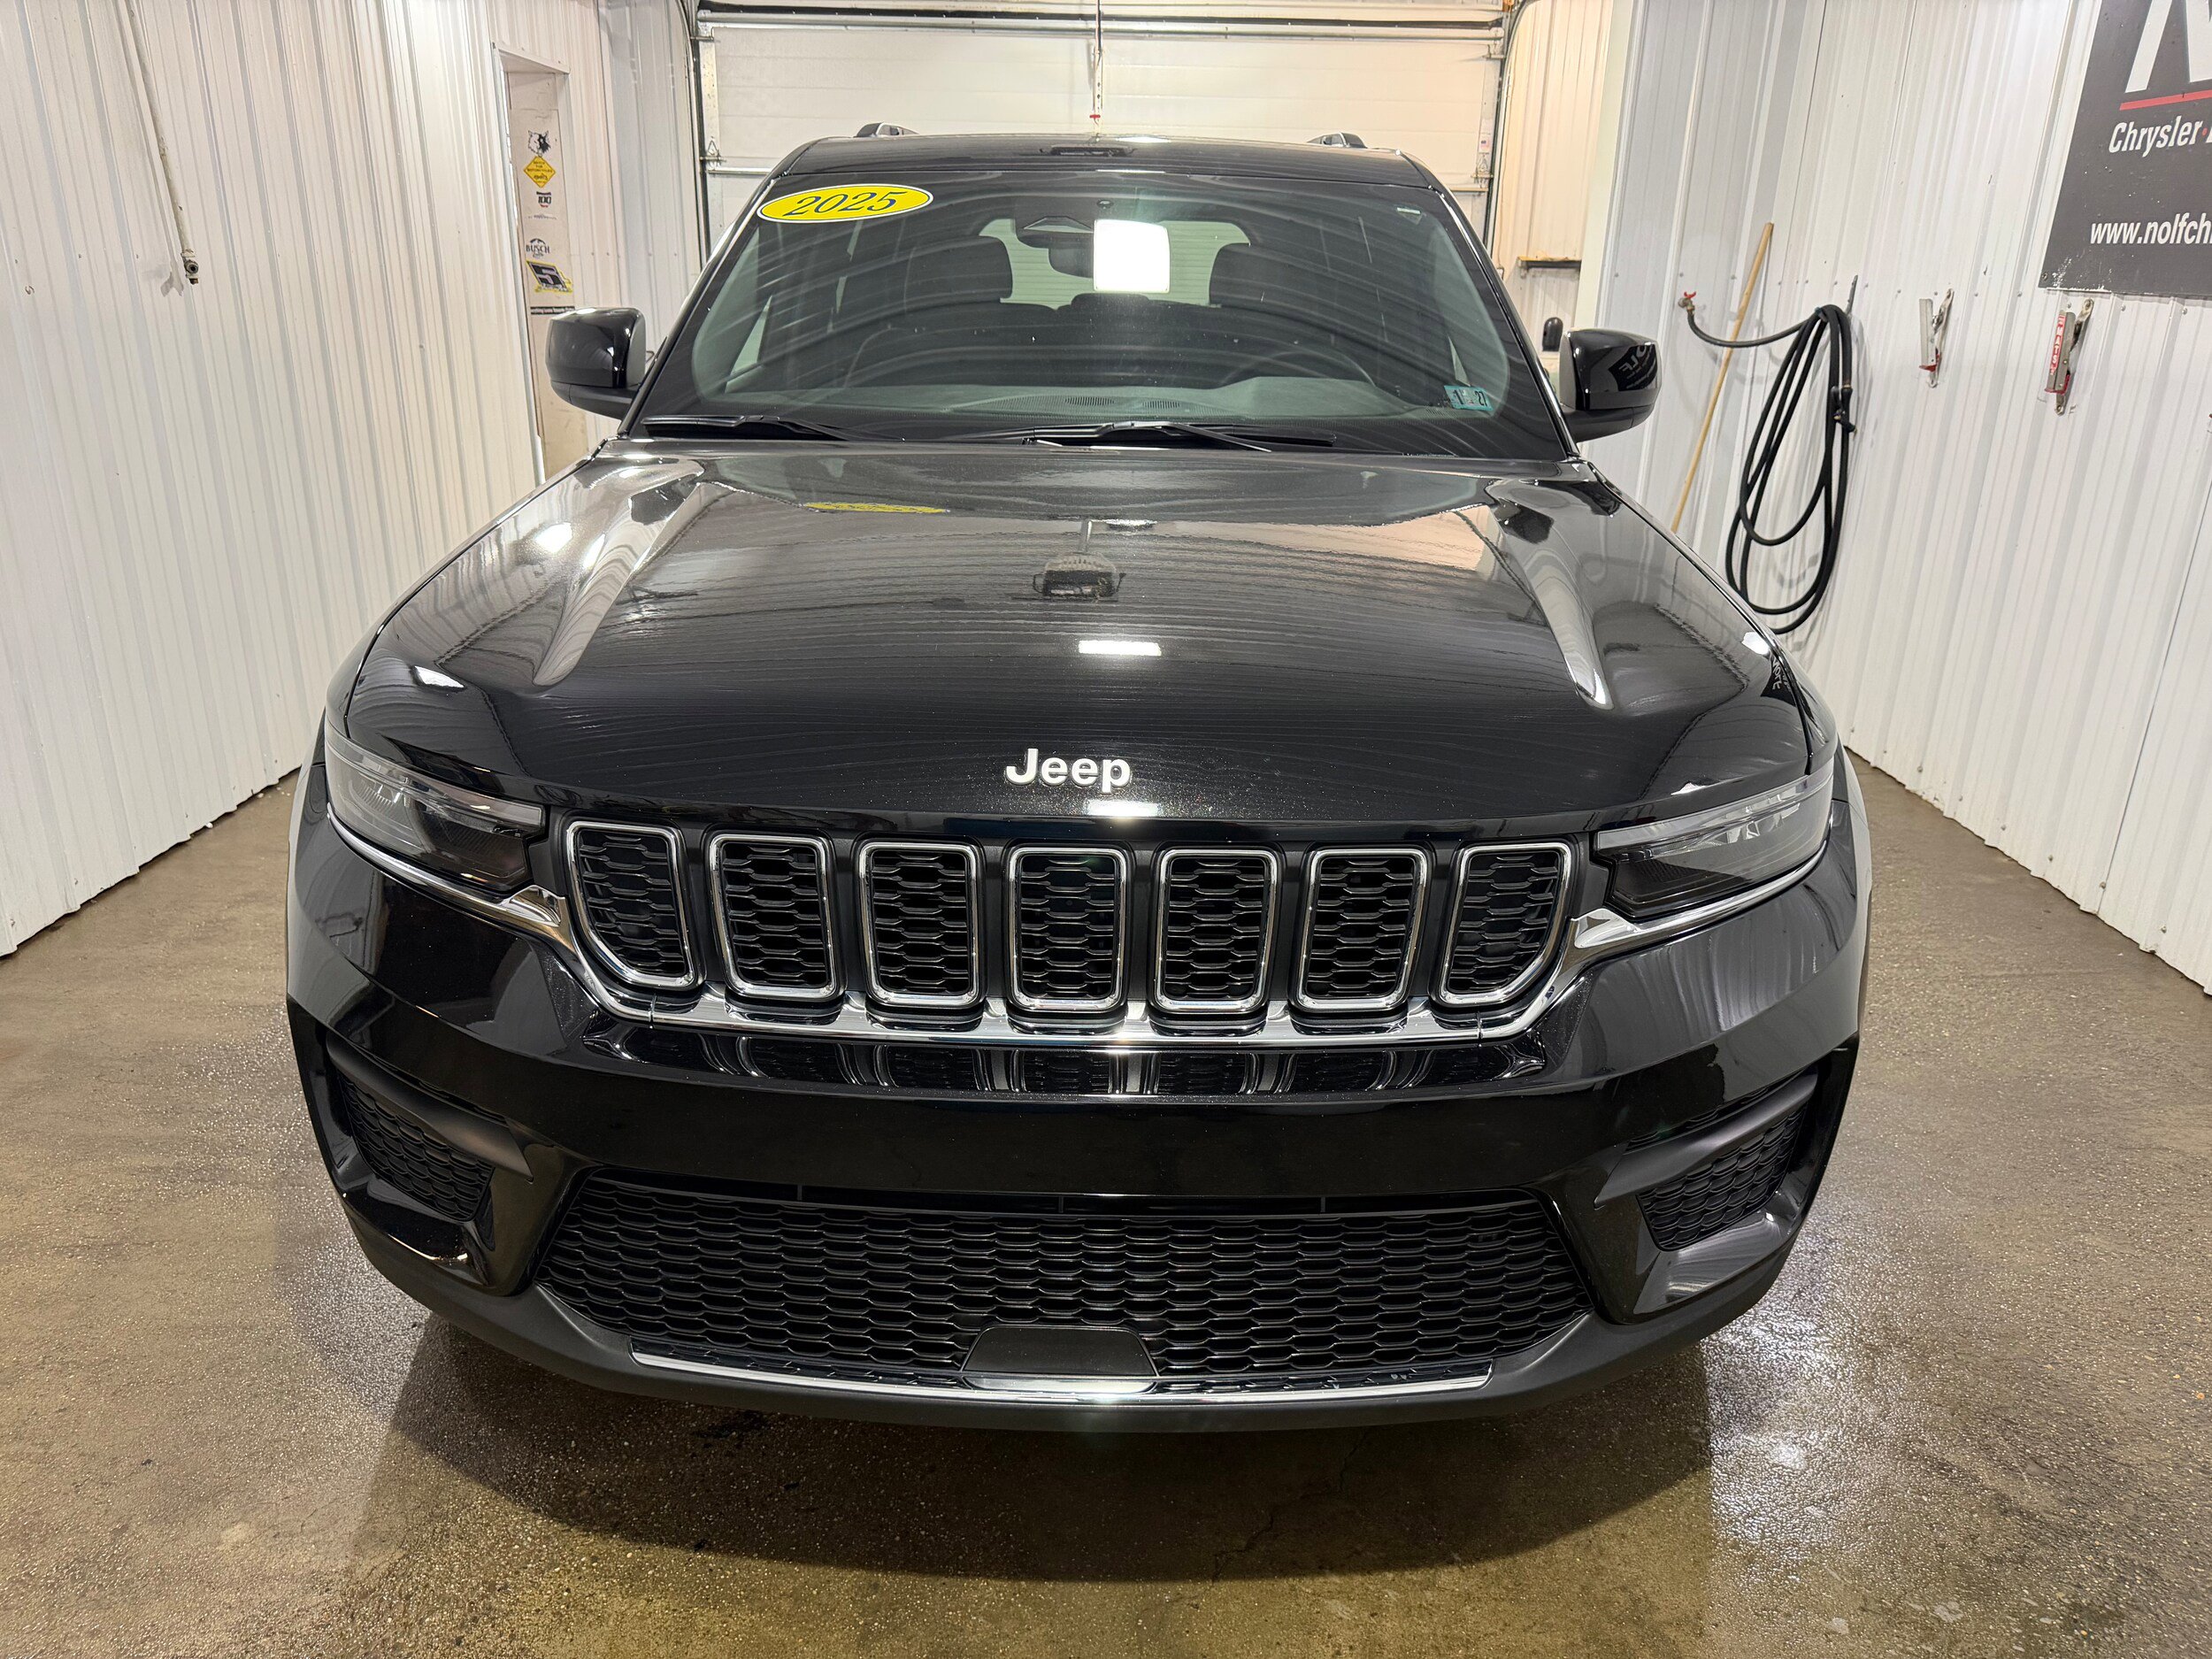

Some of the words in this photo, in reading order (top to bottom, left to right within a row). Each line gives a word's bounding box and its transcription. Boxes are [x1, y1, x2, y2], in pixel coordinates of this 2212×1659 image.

[2108, 115, 2204, 157] Chrysler
[783, 191, 908, 217] 2025
[2090, 212, 2212, 245] www.nolfch
[526, 244, 550, 254] BUSCH
[1005, 748, 1132, 794] Jeep
